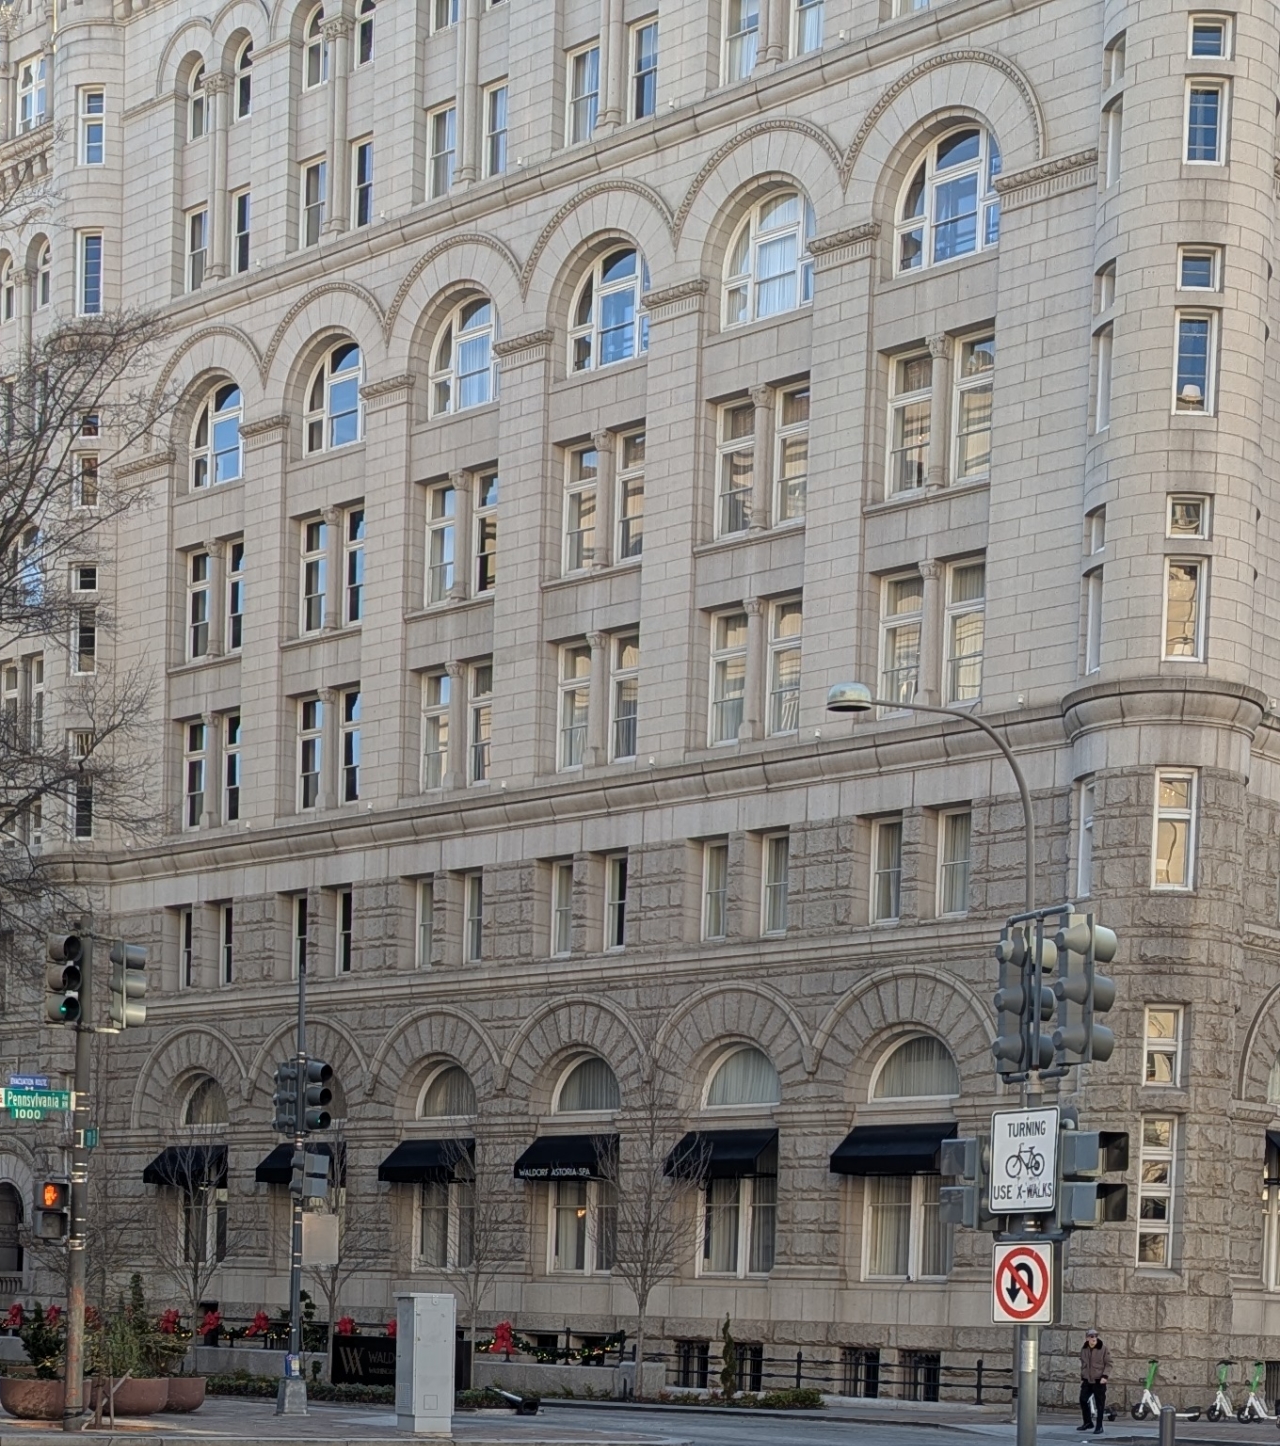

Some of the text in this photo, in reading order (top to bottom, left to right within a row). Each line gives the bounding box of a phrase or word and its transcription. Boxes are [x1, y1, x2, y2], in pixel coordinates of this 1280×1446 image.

[7, 1091, 59, 1108] Pennsylvania
[15, 1108, 41, 1119] 1000
[1007, 1120, 1046, 1138] TURNING
[519, 1168, 549, 1177] WALDORF
[551, 1167, 577, 1176] ASTORIA
[993, 1182, 1052, 1200] USE X-WALKS
